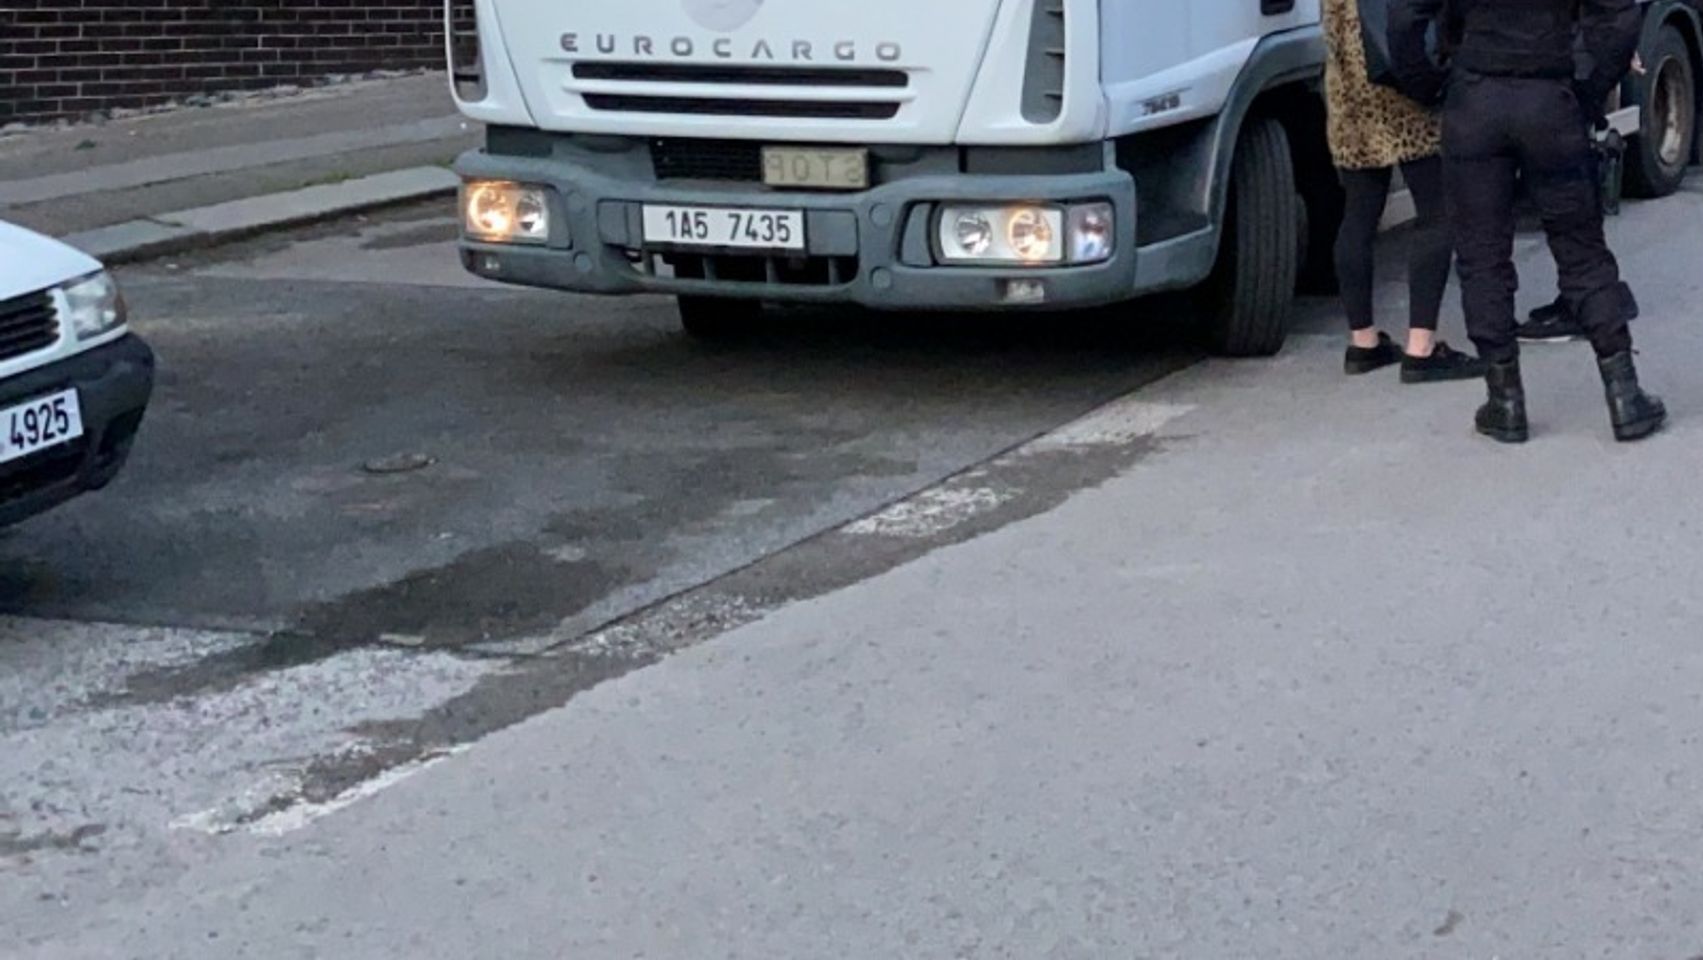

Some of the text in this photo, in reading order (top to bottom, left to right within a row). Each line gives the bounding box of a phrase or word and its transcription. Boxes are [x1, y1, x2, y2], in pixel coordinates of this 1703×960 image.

[560, 32, 902, 62] EUROCARGO
[665, 210, 791, 243] 1A5 7435
[10, 397, 70, 450] 4925
